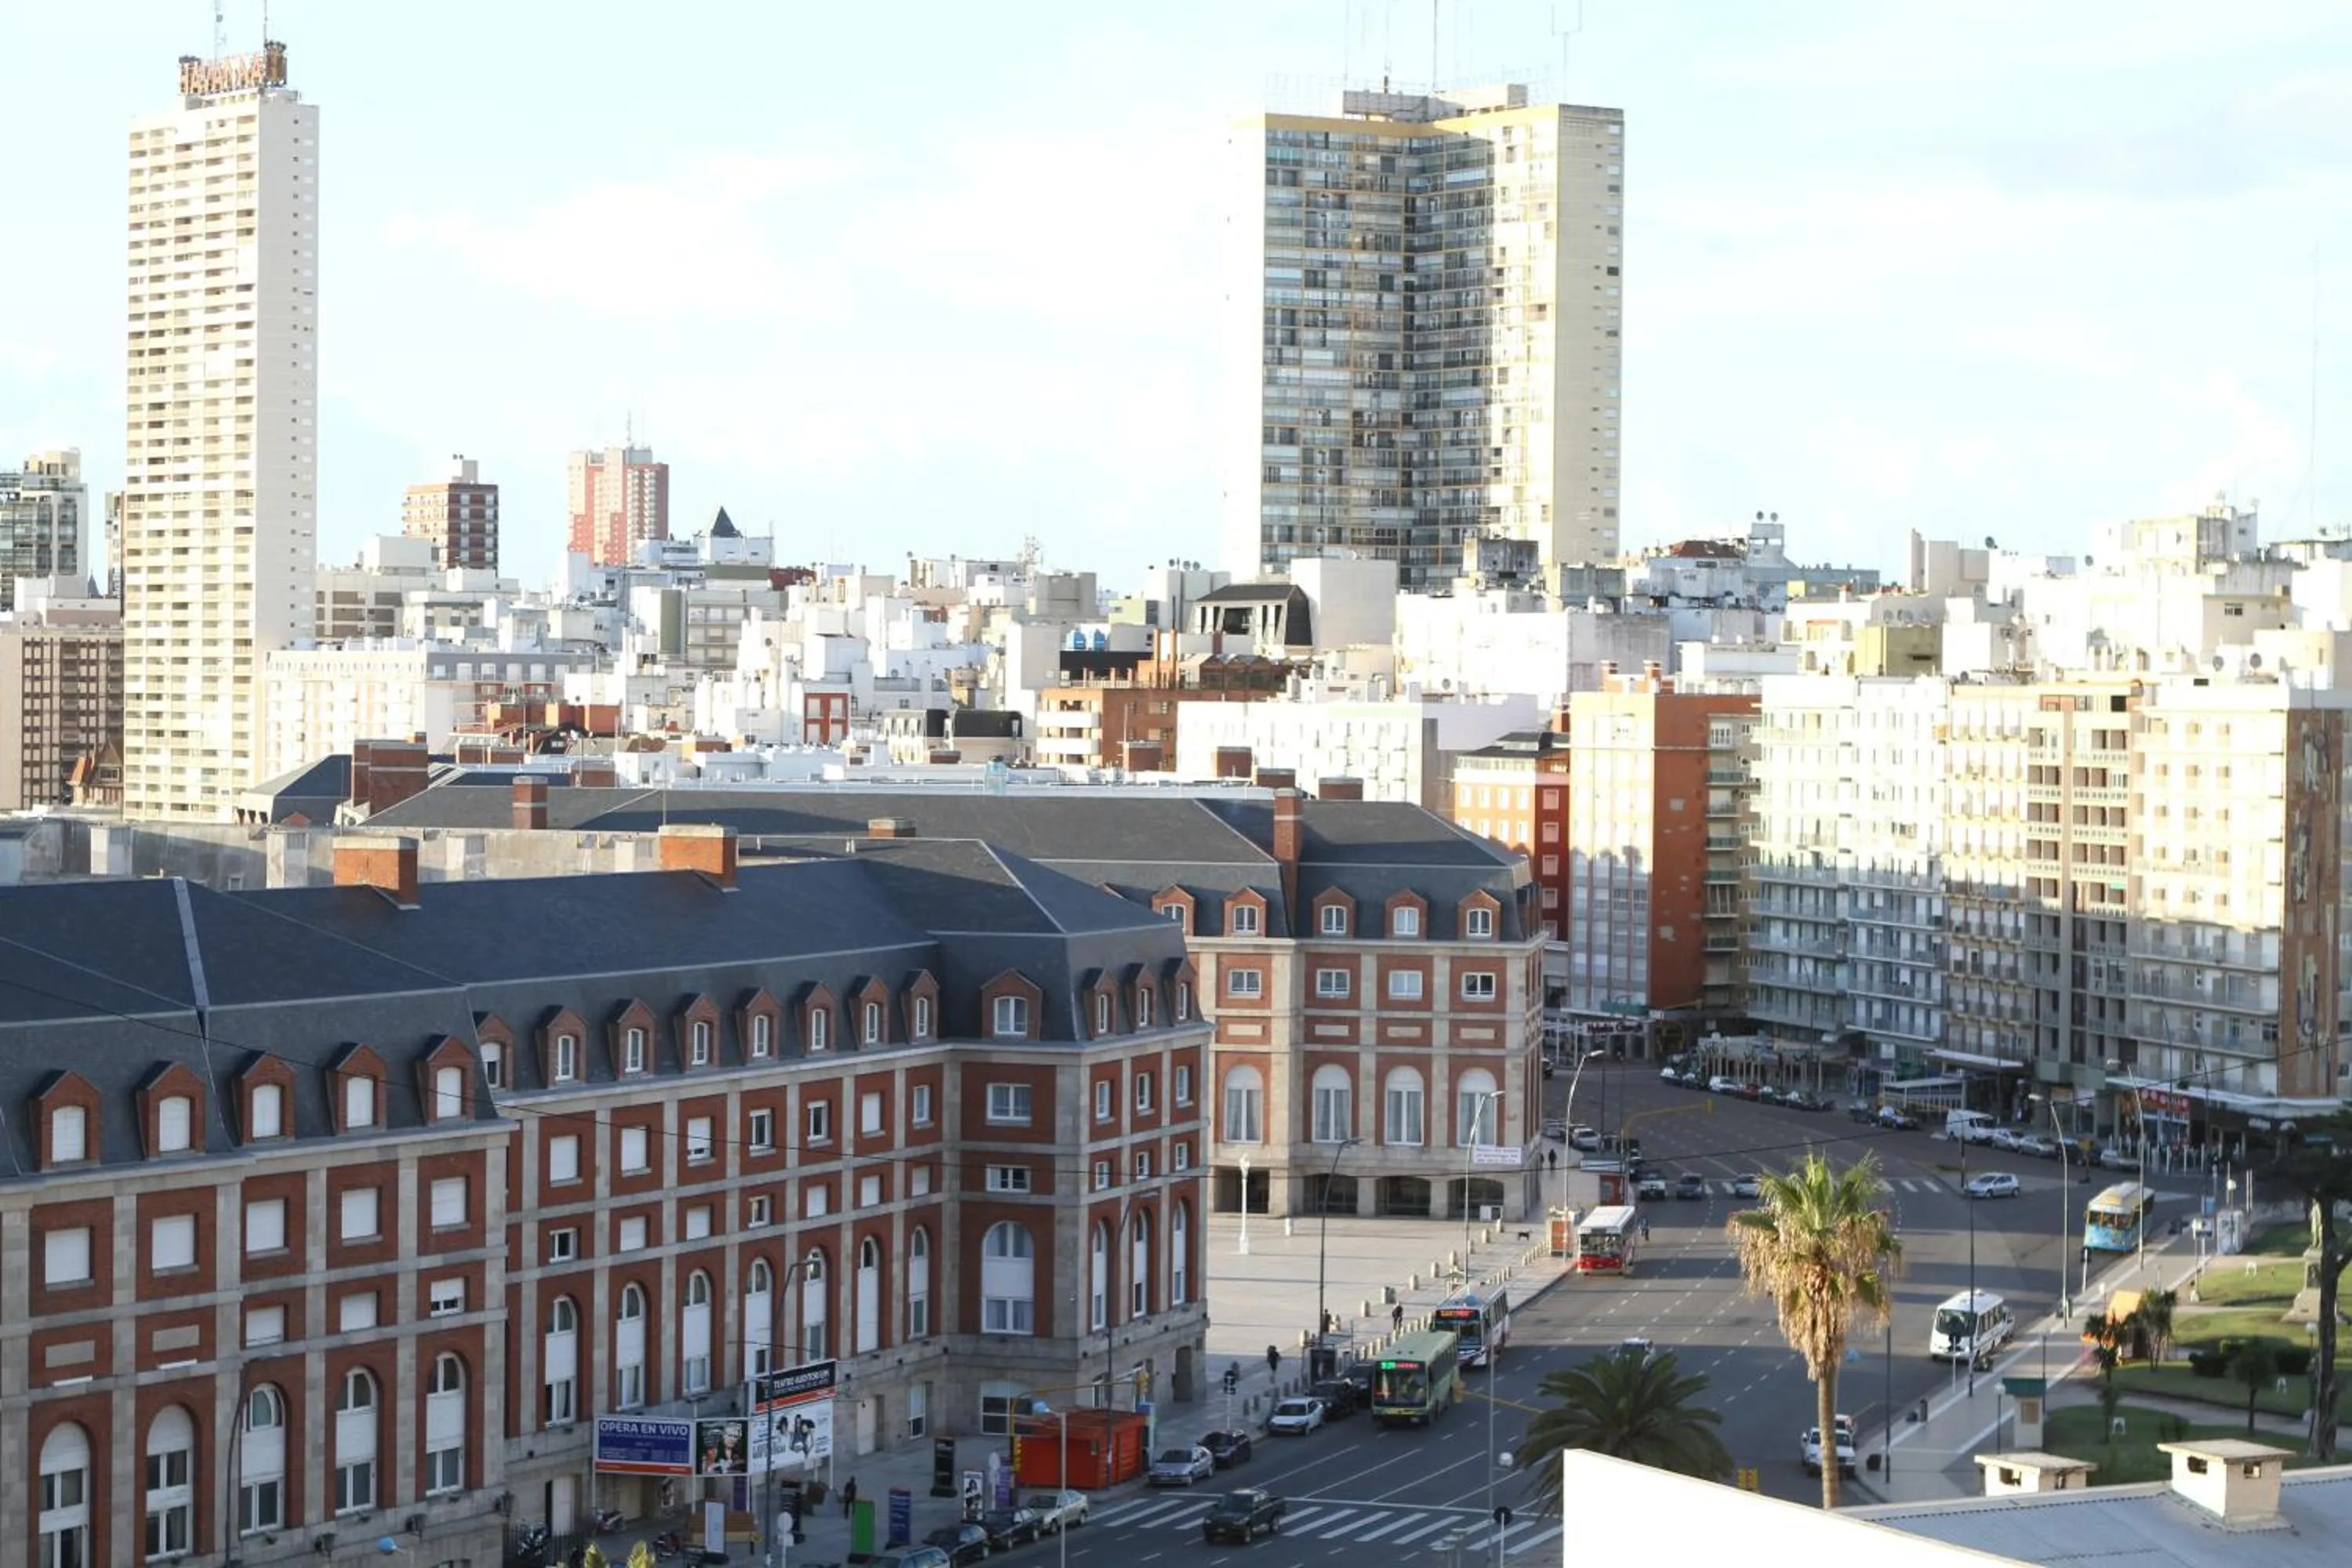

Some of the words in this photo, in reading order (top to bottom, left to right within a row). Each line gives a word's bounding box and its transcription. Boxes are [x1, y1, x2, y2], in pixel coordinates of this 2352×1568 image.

[600, 1421, 638, 1433] OPERA
[641, 1423, 656, 1435] EN
[659, 1425, 688, 1436] VIVO
